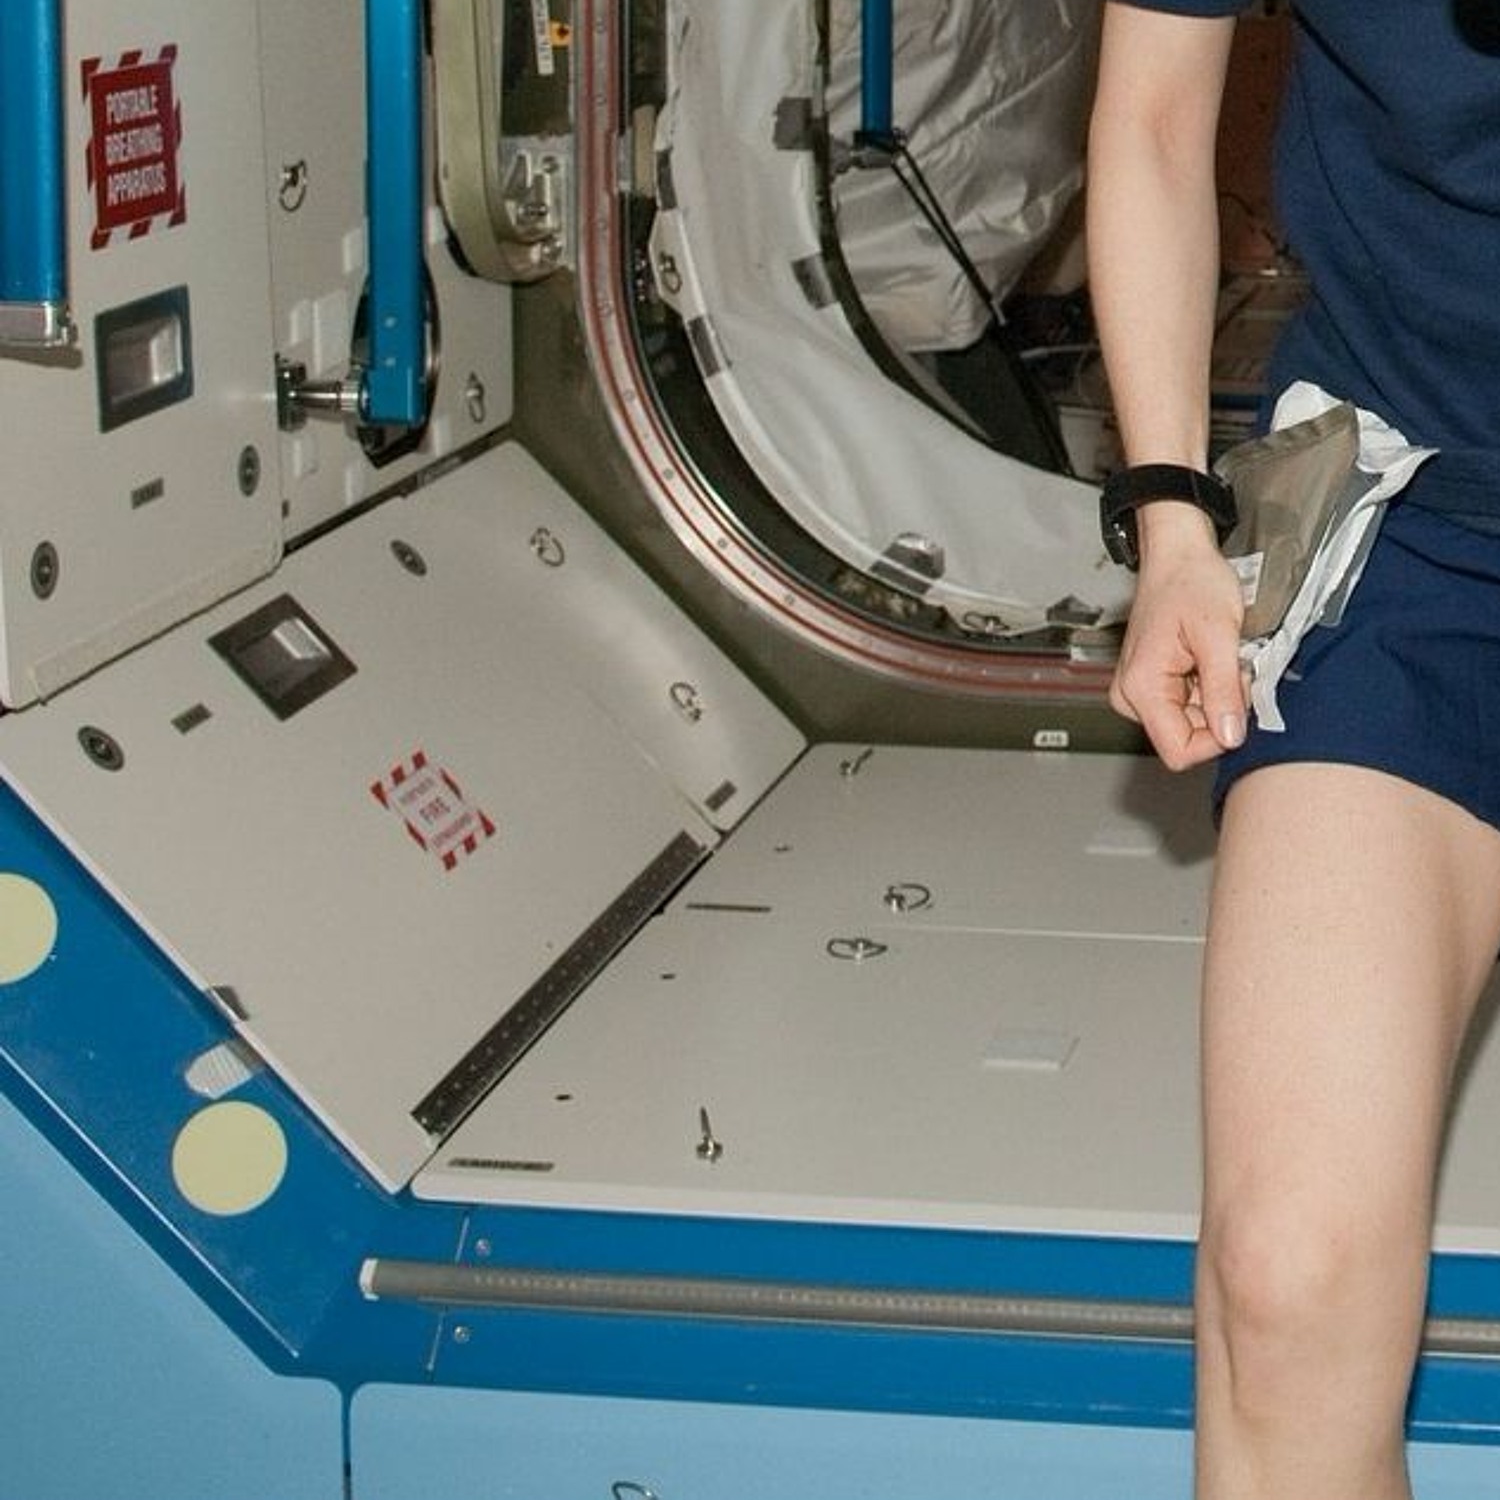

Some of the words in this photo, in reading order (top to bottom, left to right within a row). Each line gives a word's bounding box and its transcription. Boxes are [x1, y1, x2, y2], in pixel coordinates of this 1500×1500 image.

[106, 84, 159, 127] PORTABLE
[105, 122, 164, 167] BREATHING
[107, 161, 166, 207] APPARATUS
